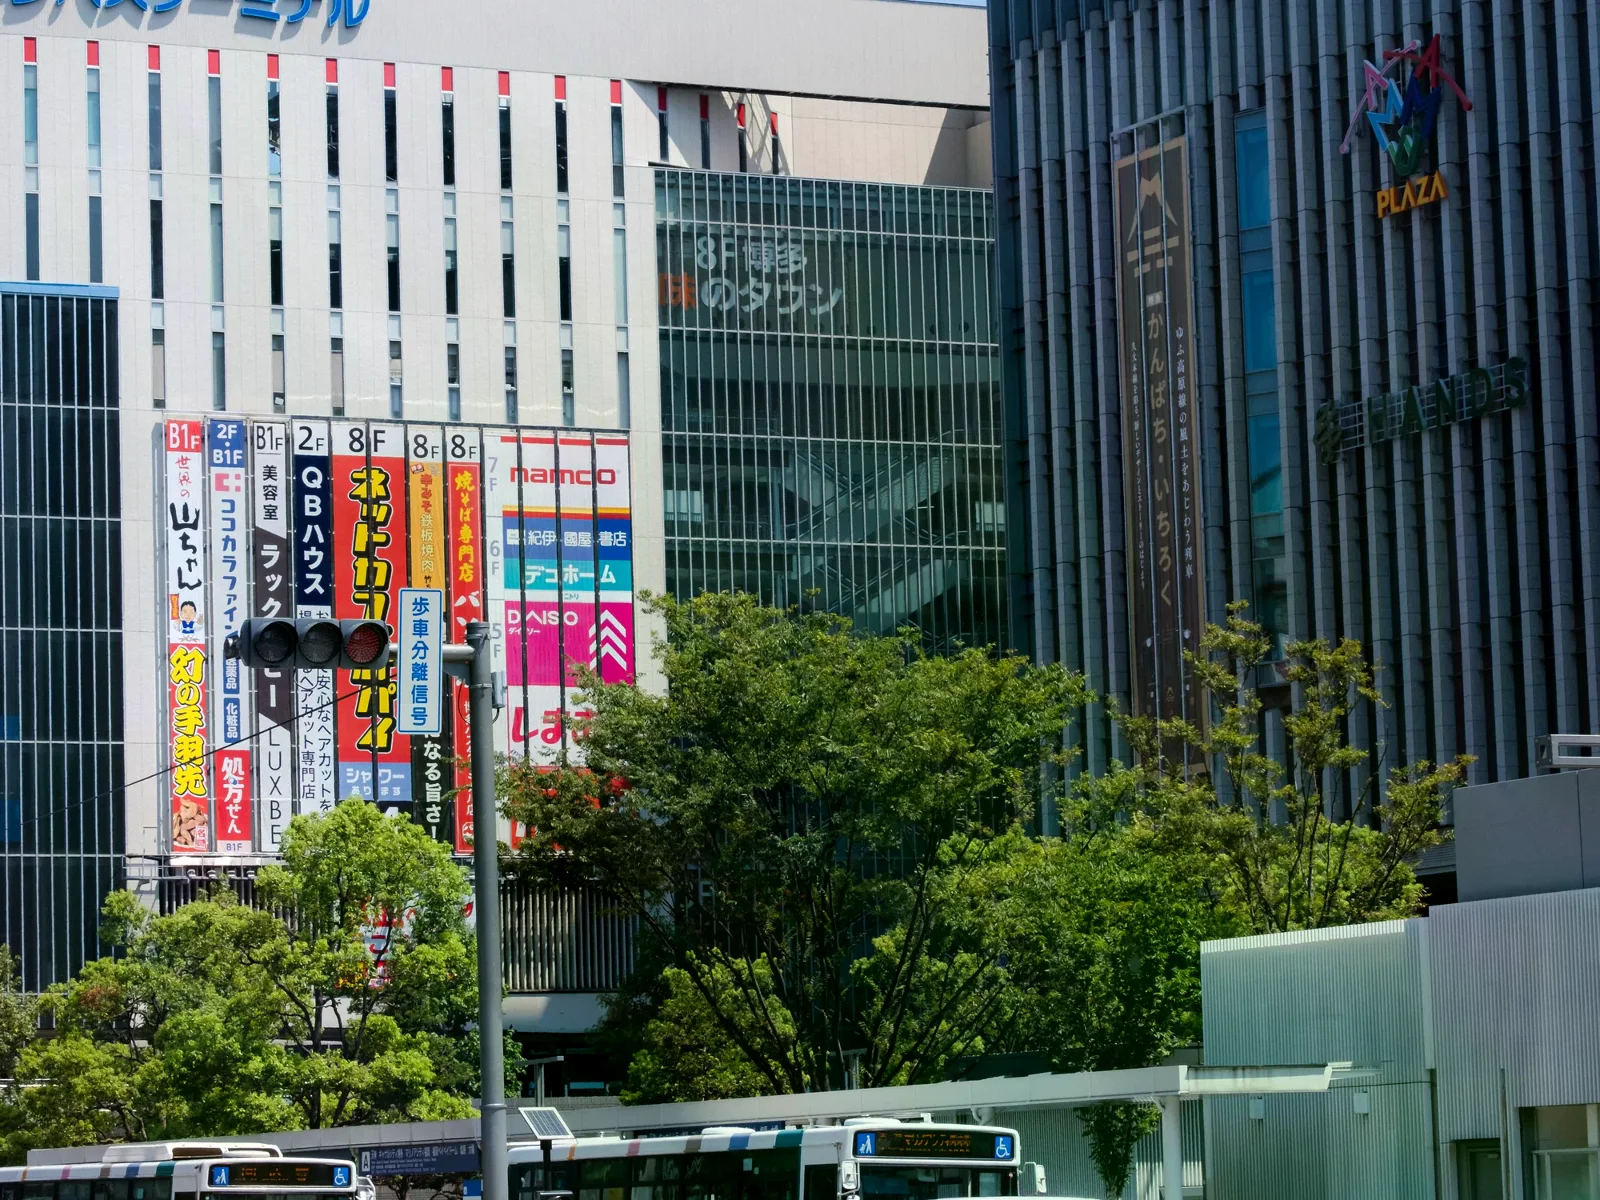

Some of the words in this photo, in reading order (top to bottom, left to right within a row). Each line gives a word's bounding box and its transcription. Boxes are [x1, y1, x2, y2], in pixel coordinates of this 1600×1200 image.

[1376, 170, 1448, 219] PLAZA
[659, 272, 842, 316] 味のタウン
[1368, 356, 1528, 444] HANDS
[169, 423, 201, 450] B1F
[256, 425, 283, 450] B1F
[298, 426, 325, 451] 2F
[349, 427, 386, 452] 8F
[413, 434, 439, 459] 8F
[451, 434, 477, 459] 8F
[510, 466, 616, 485] namco
[263, 464, 279, 521] 美容室
[302, 466, 325, 595] QBハウス
[455, 470, 475, 583] 焼そば専門店
[528, 530, 627, 547] 紀伊國屋書店
[525, 563, 617, 585] デコホーム
[564, 592, 579, 600] ニトリ
[508, 609, 579, 626] DAISO
[411, 596, 429, 726] 歩車分離信号
[169, 646, 207, 796] 幻の手羽先
[226, 702, 238, 739] 化粧品
[346, 768, 404, 784] シャワー
[221, 756, 244, 835] 処方せん
[351, 785, 401, 796] あります
[226, 842, 243, 851] B1F
